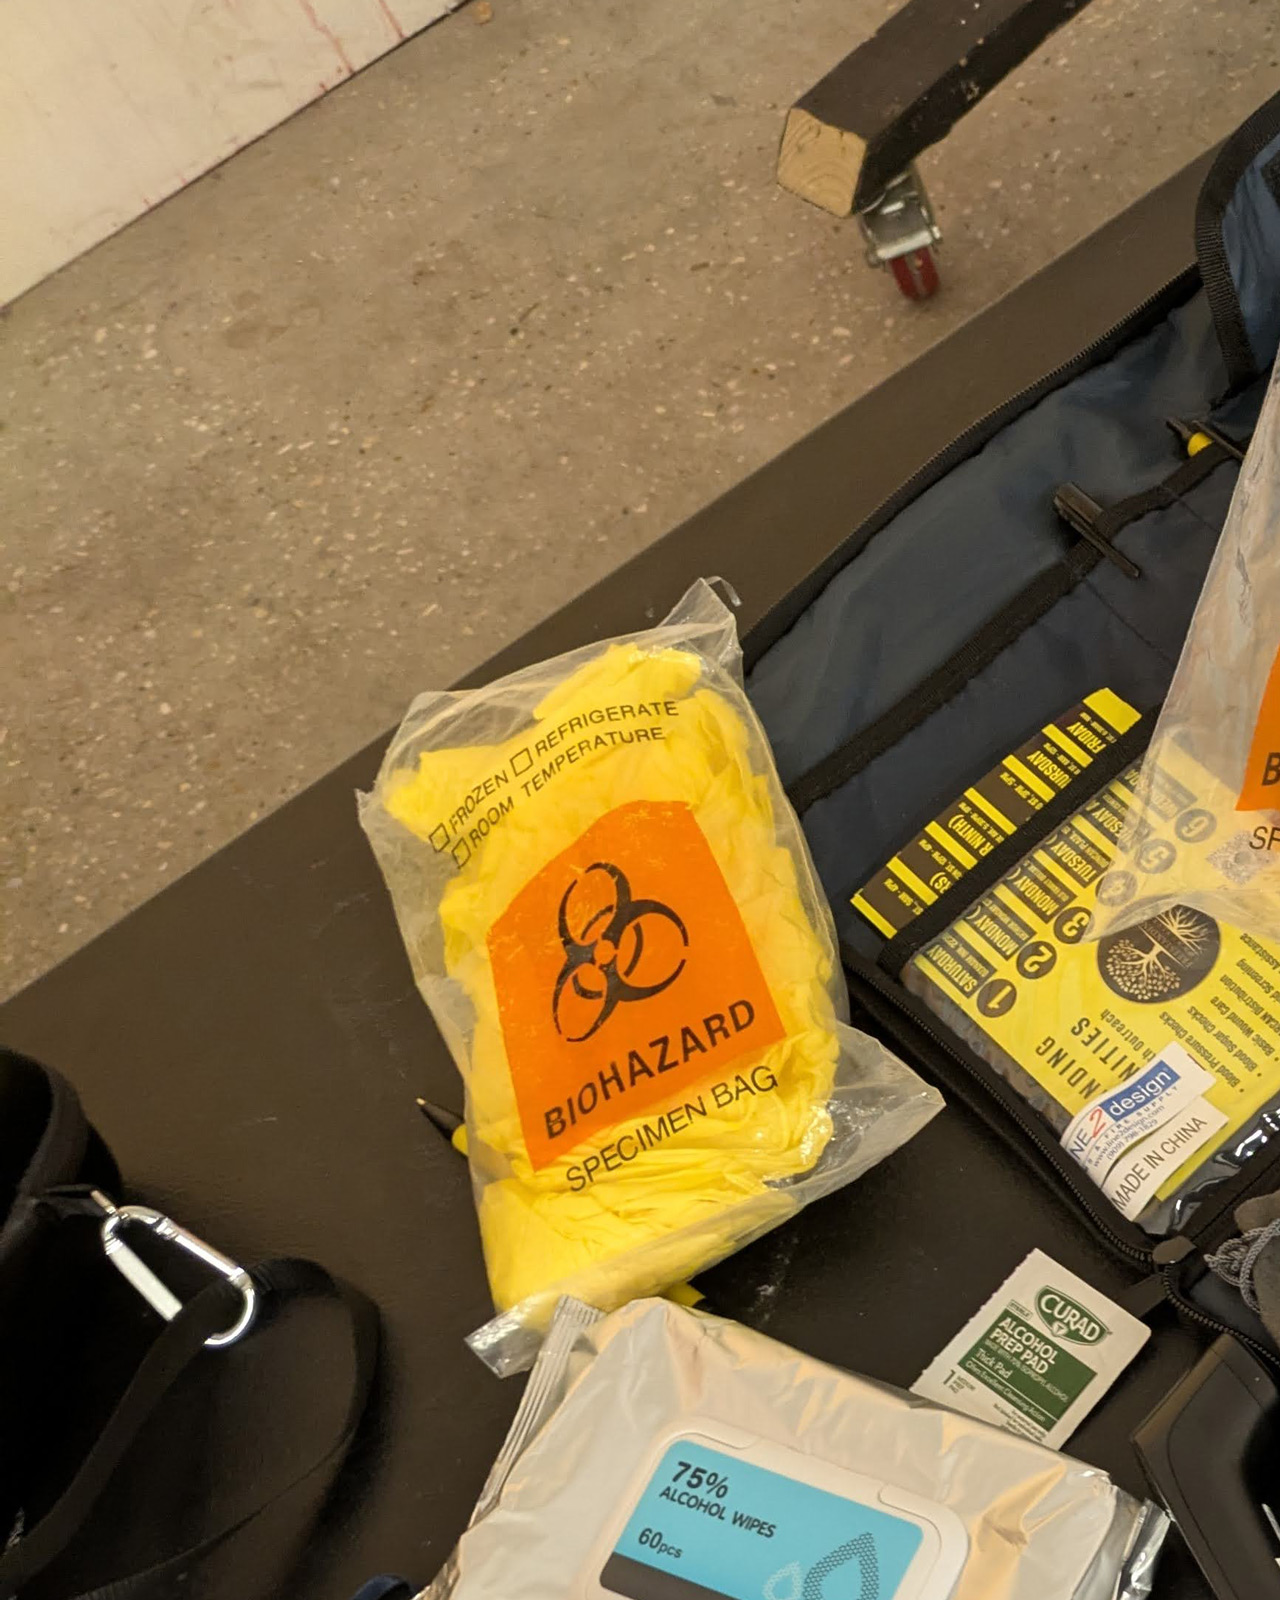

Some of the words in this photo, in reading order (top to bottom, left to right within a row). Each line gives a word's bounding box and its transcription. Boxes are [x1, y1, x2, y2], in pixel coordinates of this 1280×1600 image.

[1066, 722, 1106, 754] FRIDAY
[449, 773, 508, 836] FROZEN
[535, 700, 679, 757] REFRIGERATE
[470, 796, 515, 850] ROOM
[520, 726, 666, 796] TEMPERATURE
[948, 814, 986, 850] NINTH)
[1050, 841, 1097, 882] TUESDAY
[1014, 876, 1059, 916] MONDAY
[974, 915, 1019, 956] MONDAY
[1062, 912, 1091, 937] 3
[929, 945, 978, 992] SATURDAY
[1024, 945, 1053, 973] 2
[1240, 933, 1280, 970] Assistance
[1236, 958, 1274, 994] Screening
[988, 985, 1012, 1009] 1
[1210, 996, 1225, 1011] Care
[1220, 974, 1264, 1016] Distribution
[1100, 1009, 1145, 1052] Outreach
[1159, 1011, 1188, 1040] Checks
[1187, 1006, 1216, 1034] Checks
[1222, 1007, 1254, 1038] Wound
[1185, 1035, 1220, 1069] Pressure
[1212, 1030, 1238, 1053] Sugar
[1252, 1034, 1275, 1056] Basic
[543, 999, 755, 1140] BIOHAZARD
[1216, 1065, 1240, 1087] Blood
[1233, 1049, 1257, 1072] Blood
[1136, 1087, 1178, 1117] SUPPLY
[565, 1095, 705, 1192] SPECIMEN
[711, 1065, 778, 1107] BAG
[1112, 1163, 1150, 1210] MADE
[1143, 1150, 1165, 1169] IN
[1161, 1117, 1207, 1155] CHINA
[1040, 1294, 1100, 1341] CURAD
[990, 1328, 1024, 1354] PREP
[1020, 1349, 1049, 1374] PAD
[998, 1317, 1058, 1365] ALCOHOL
[943, 1369, 955, 1385] 1
[976, 1348, 996, 1367] Thick
[994, 1362, 1013, 1379] Pad
[965, 1360, 982, 1375] Offers
[980, 1371, 1004, 1392] Excellent
[1003, 1388, 1030, 1411] Cleansing
[1028, 1407, 1046, 1422] Action
[671, 1461, 729, 1498] 75%
[659, 1486, 725, 1520] ALCOHOL
[732, 1511, 777, 1538] WIPES
[638, 1528, 682, 1559] 60pcs
